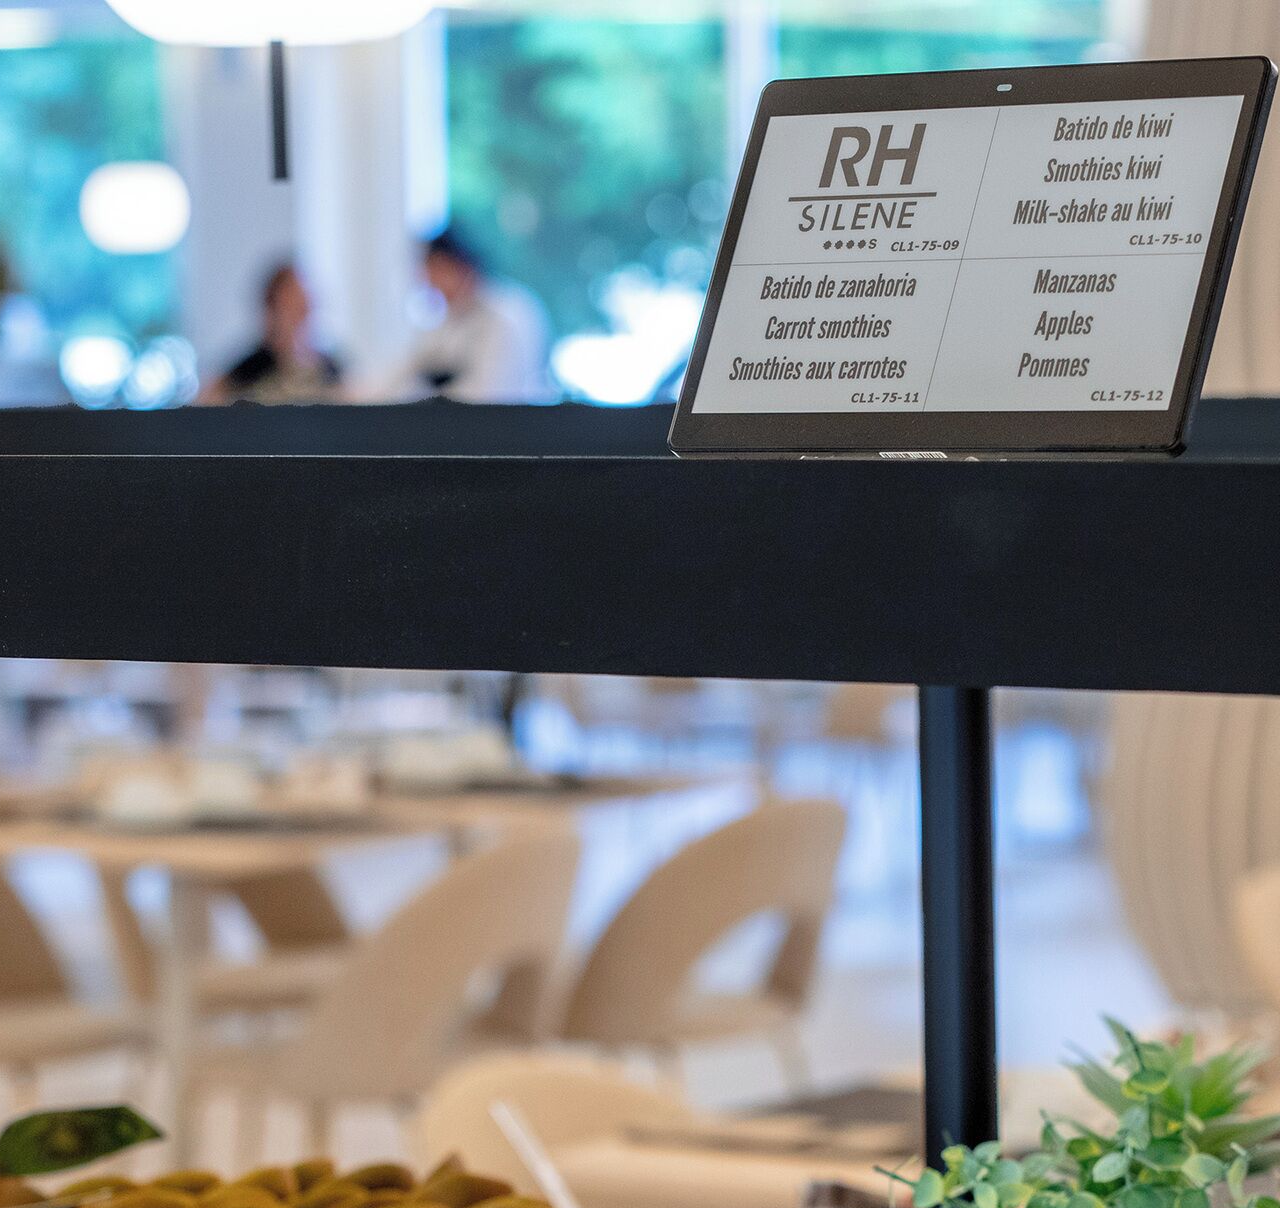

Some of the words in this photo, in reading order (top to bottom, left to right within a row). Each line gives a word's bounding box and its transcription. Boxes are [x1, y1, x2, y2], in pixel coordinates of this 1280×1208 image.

[1053, 116, 1108, 142] Batido
[1112, 115, 1133, 139] de
[1136, 112, 1174, 138] kiwi
[818, 123, 927, 188] RH
[1043, 156, 1123, 183] Smothies
[1125, 154, 1163, 180] kiwi
[798, 201, 917, 232] SILENE
[1013, 198, 1108, 225] Milk-shake
[1110, 202, 1134, 222] au
[1136, 195, 1174, 221] kiwi
[890, 240, 960, 252] CL1-75-09
[1129, 233, 1202, 246] CL1-75-10
[760, 275, 812, 300] Batido
[815, 275, 835, 299] de
[837, 272, 917, 298] zanahoria
[1033, 269, 1118, 294] Manzanas
[764, 315, 816, 340] Carrot
[817, 314, 892, 340] smothies
[1034, 310, 1094, 341] Apples
[728, 356, 804, 381] Smothies
[805, 360, 836, 380] aux
[838, 356, 907, 380] carrotes
[1017, 352, 1091, 378] Pommes
[851, 392, 919, 404] CL1-75-11
[1090, 390, 1164, 402] CL1-75-12
